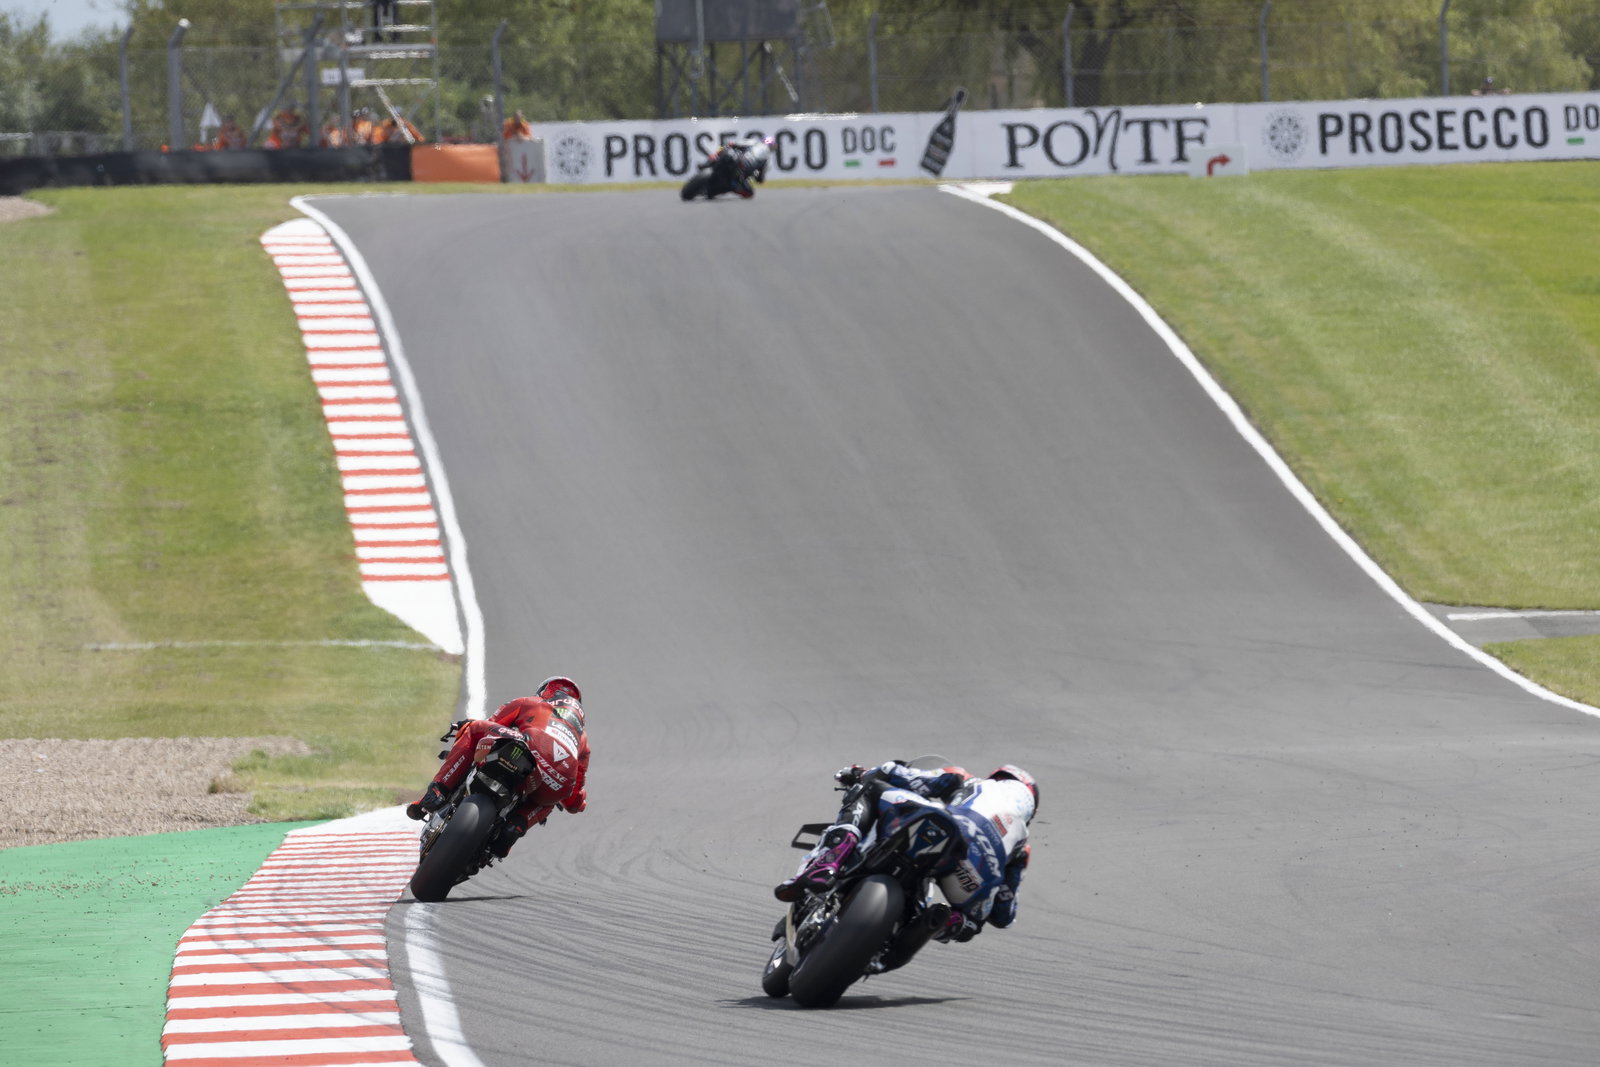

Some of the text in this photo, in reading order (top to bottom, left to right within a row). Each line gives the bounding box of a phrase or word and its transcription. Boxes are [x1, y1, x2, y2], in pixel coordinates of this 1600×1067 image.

[604, 128, 828, 177] PROSCO
[841, 126, 896, 154] DOC
[1318, 107, 1549, 155] PROSECCO
[530, 750, 569, 783] DAINESE
